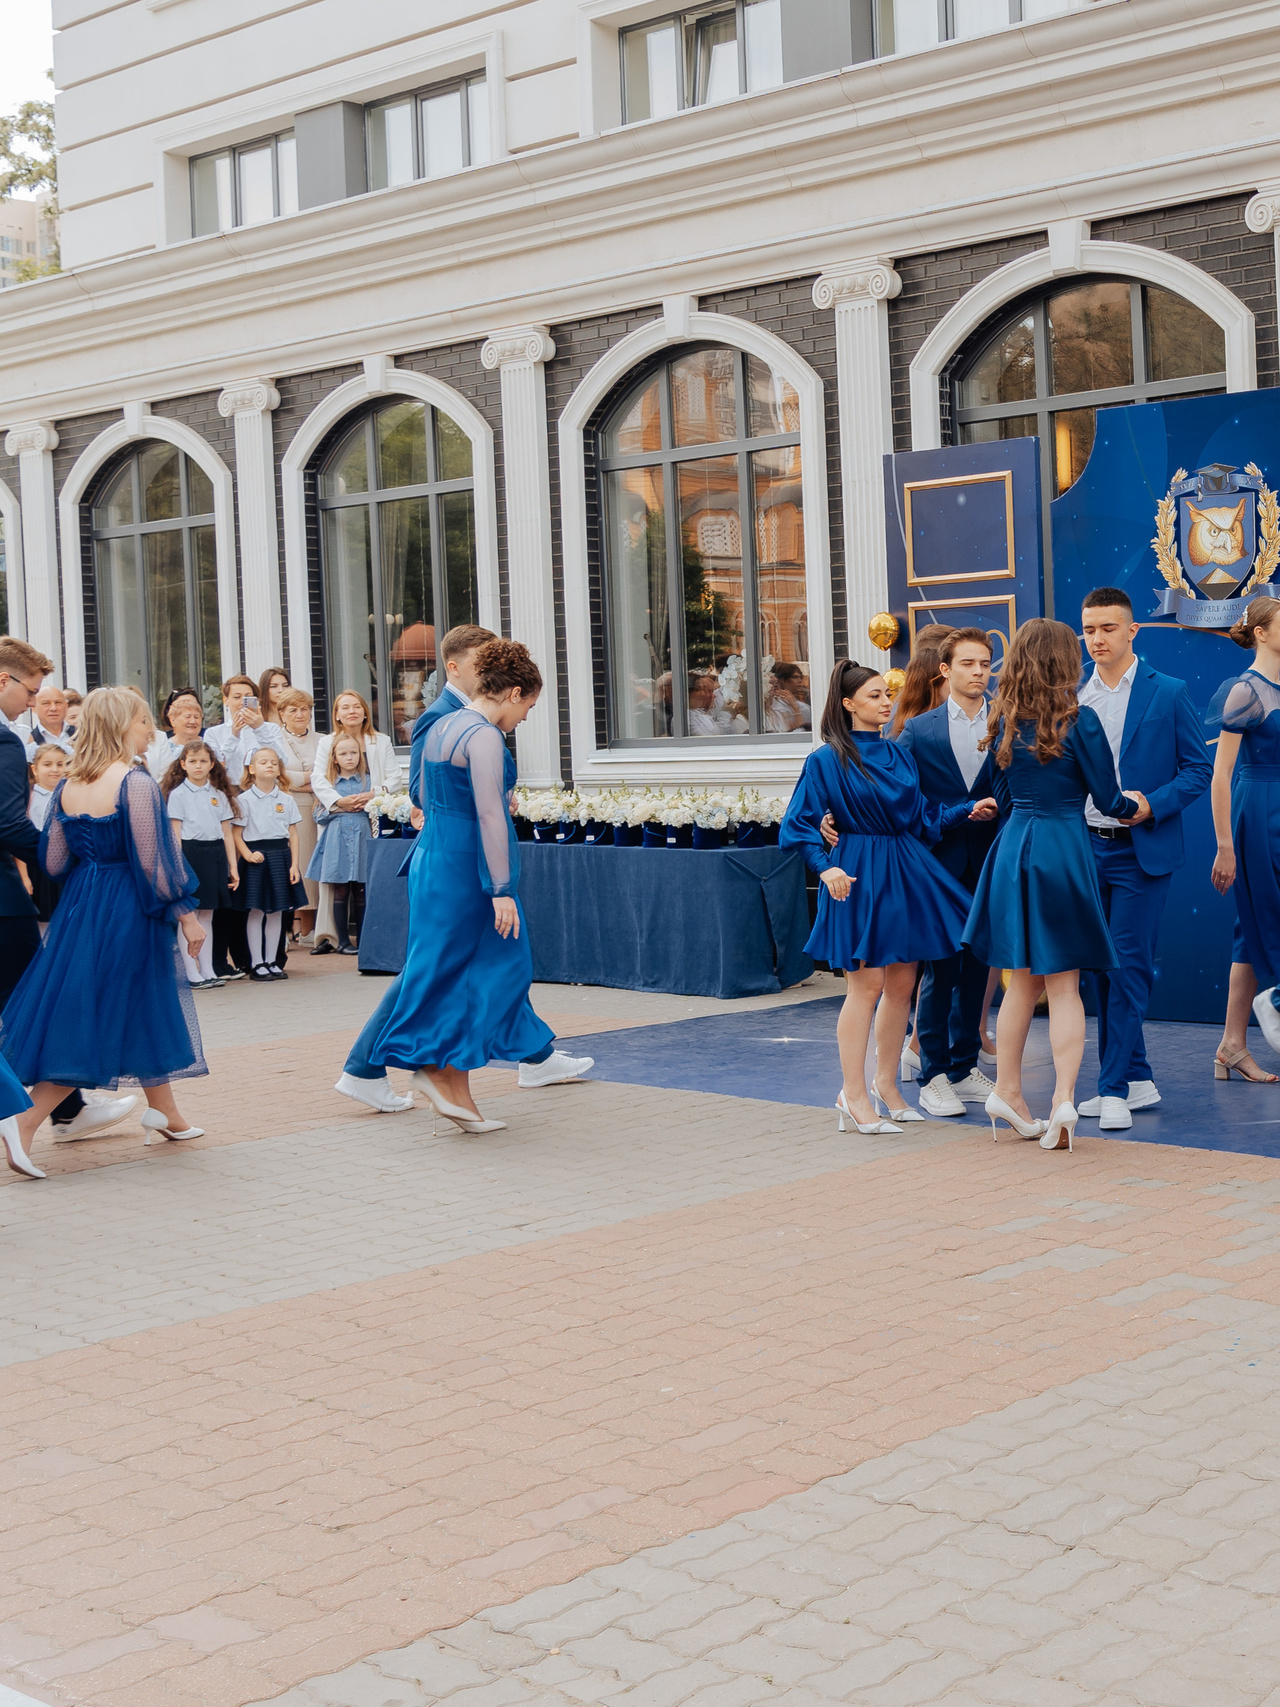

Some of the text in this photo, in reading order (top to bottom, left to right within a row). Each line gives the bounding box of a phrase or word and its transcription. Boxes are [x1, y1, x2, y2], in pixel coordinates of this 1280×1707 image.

[1195, 604, 1241, 612] SAPERE AUDE
[1186, 613, 1243, 623] DIVES QUAM SCIEN
